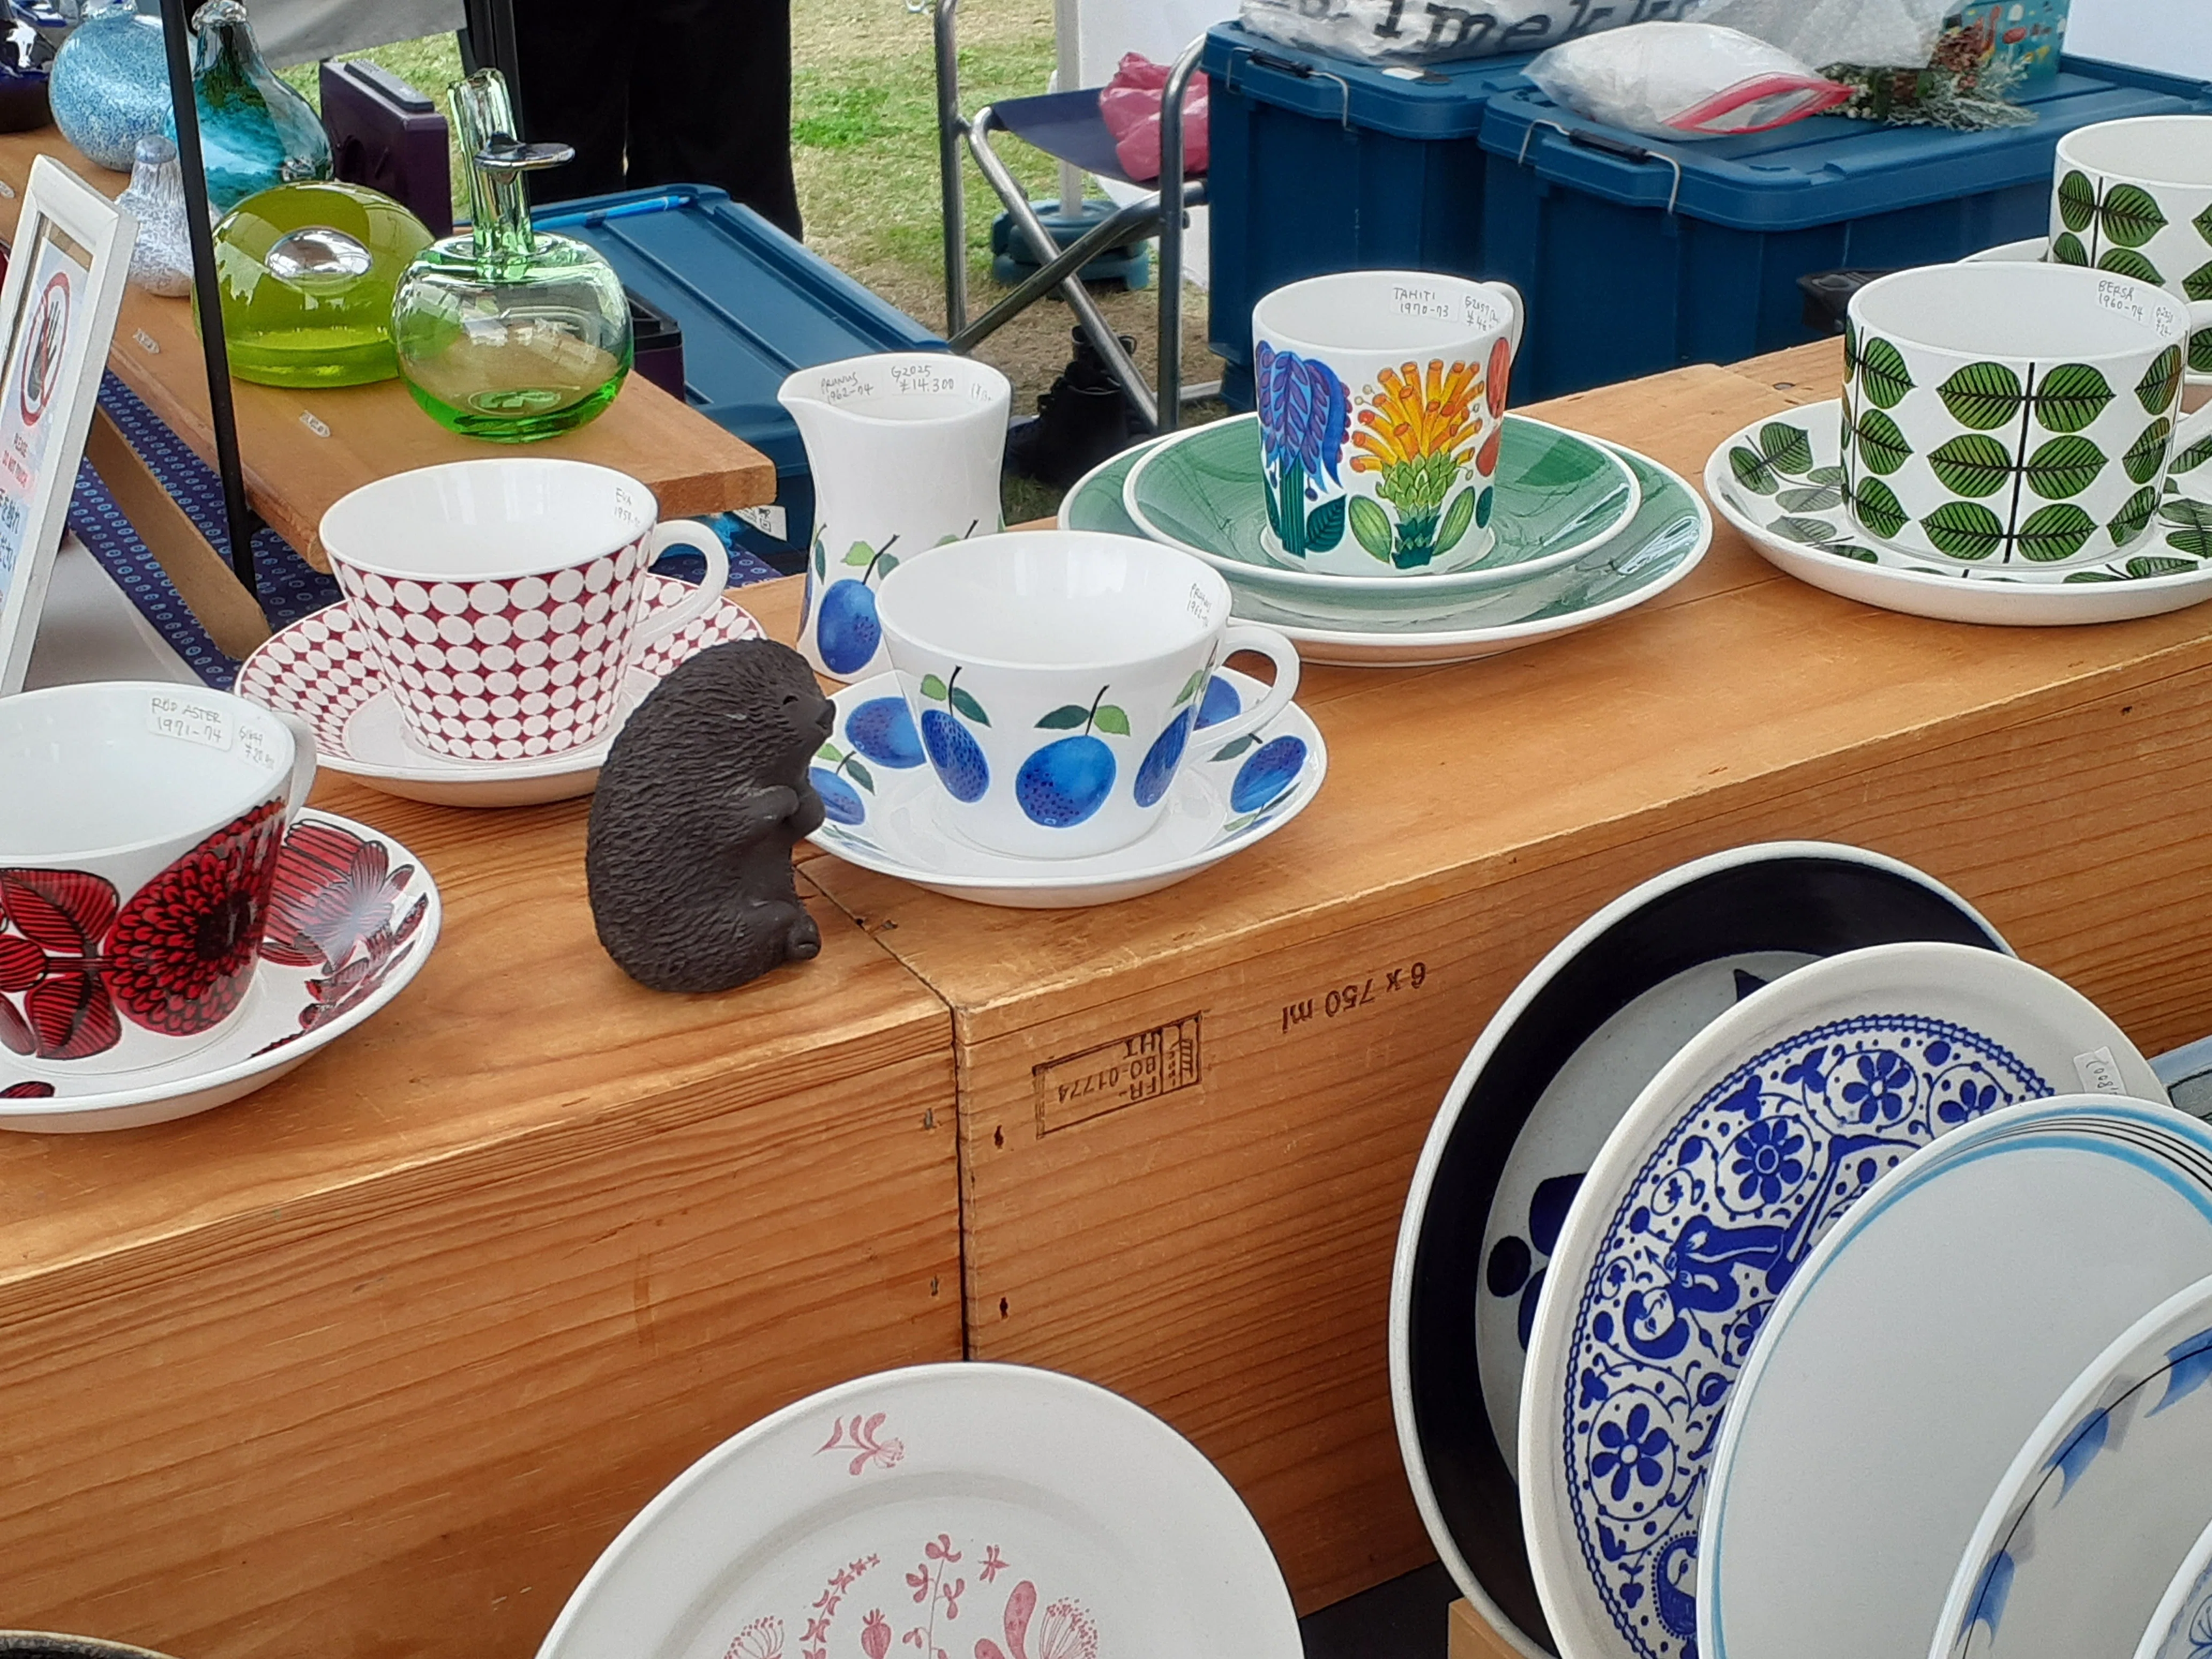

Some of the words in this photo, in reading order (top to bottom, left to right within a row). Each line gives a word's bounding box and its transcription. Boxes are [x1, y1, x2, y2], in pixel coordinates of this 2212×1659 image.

[1393, 287, 1435, 301] TAHITI
[2098, 293, 2143, 322] 1960-74
[1400, 302, 1449, 318] 1970-73
[821, 371, 858, 394] PRUNUS
[891, 365, 932, 383] G2025
[182, 705, 221, 723] ASTER
[158, 716, 221, 744] 1971-74
[1386, 968, 1403, 992] x
[1411, 962, 1426, 989] 6
[1325, 978, 1376, 1018] 750
[1282, 998, 1313, 1034] ml
[1123, 1031, 1156, 1060] HT
[1058, 1055, 1156, 1104] BO-01774
